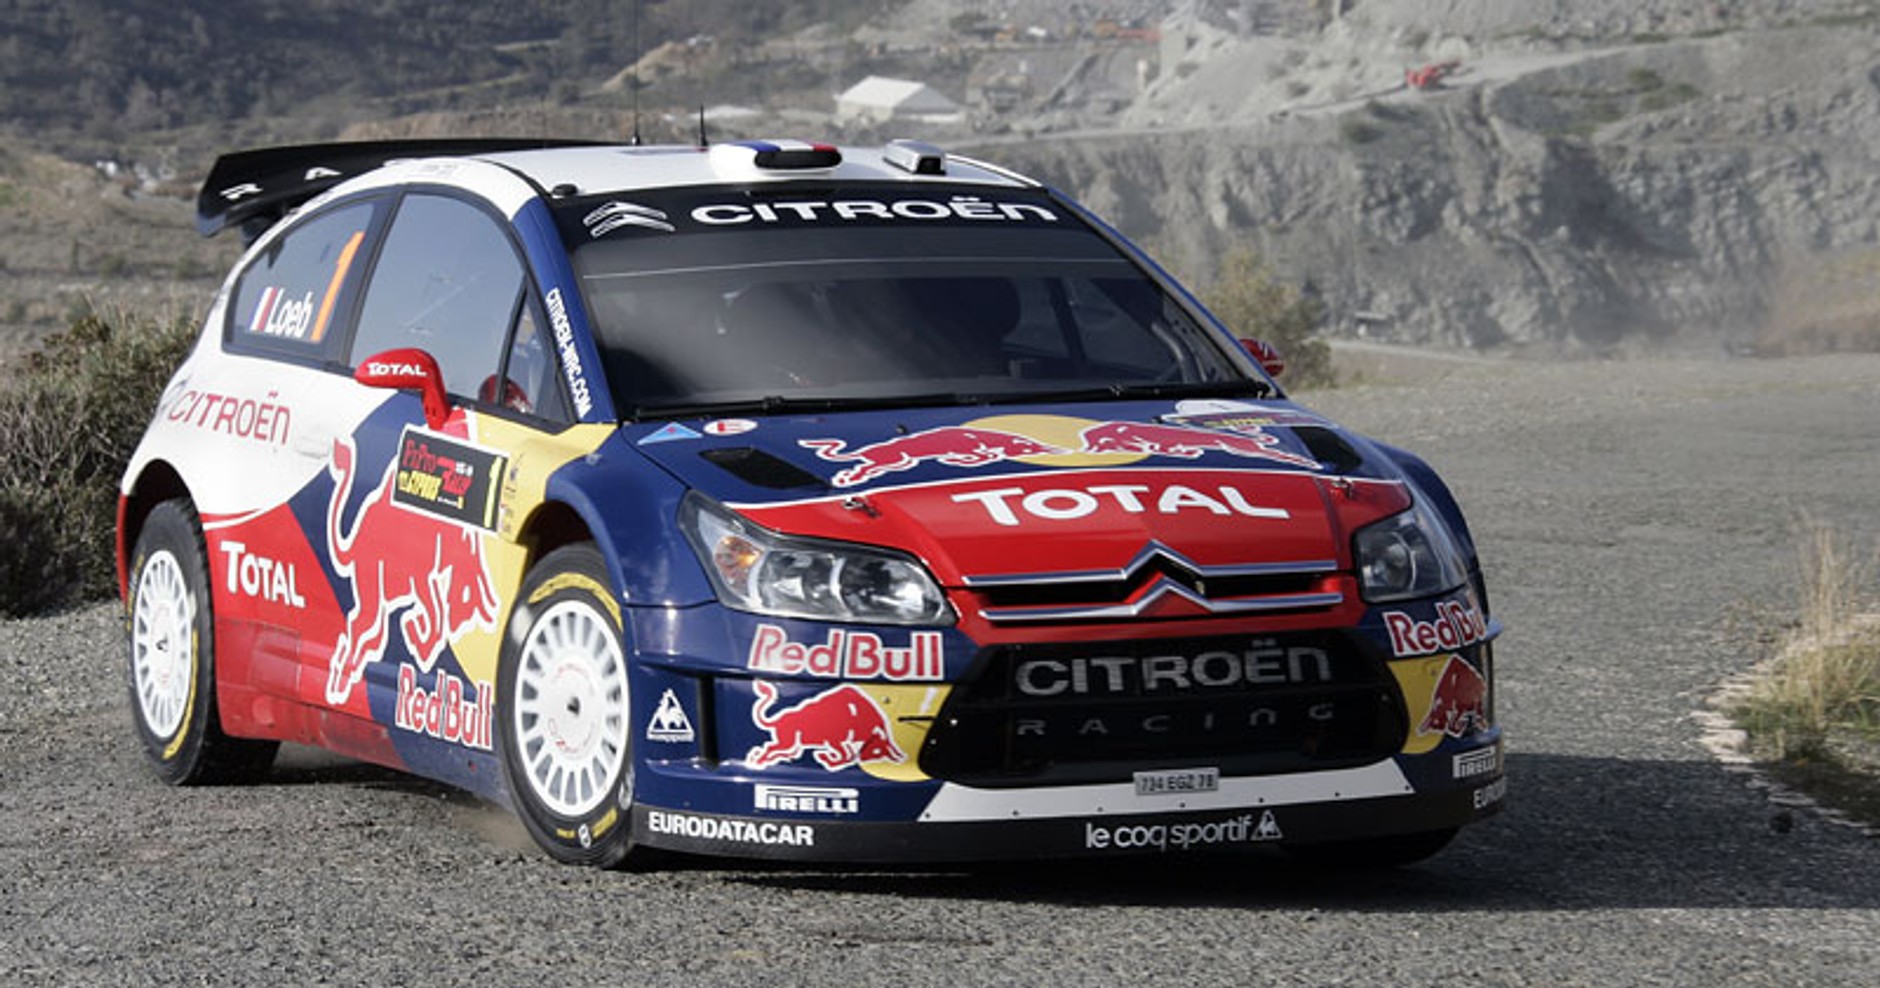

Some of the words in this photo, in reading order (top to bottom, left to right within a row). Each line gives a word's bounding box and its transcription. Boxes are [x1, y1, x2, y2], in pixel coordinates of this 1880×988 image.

[310, 230, 366, 344] 1
[264, 287, 314, 338] Loeb
[367, 361, 428, 377] TOTAL
[484, 456, 502, 529] 1
[951, 485, 1291, 526] TOTAL
[220, 540, 306, 608] TOTAL
[749, 624, 844, 678] Red
[844, 631, 944, 680] Bull
[1383, 611, 1460, 656] Red
[396, 664, 446, 737] Red
[441, 675, 494, 750] Bull
[755, 785, 859, 813] PIRELLI
[649, 811, 814, 846] EURODATACAR
[1086, 823, 1110, 848] le
[1114, 825, 1167, 852] coq
[1170, 814, 1252, 849] sportif
